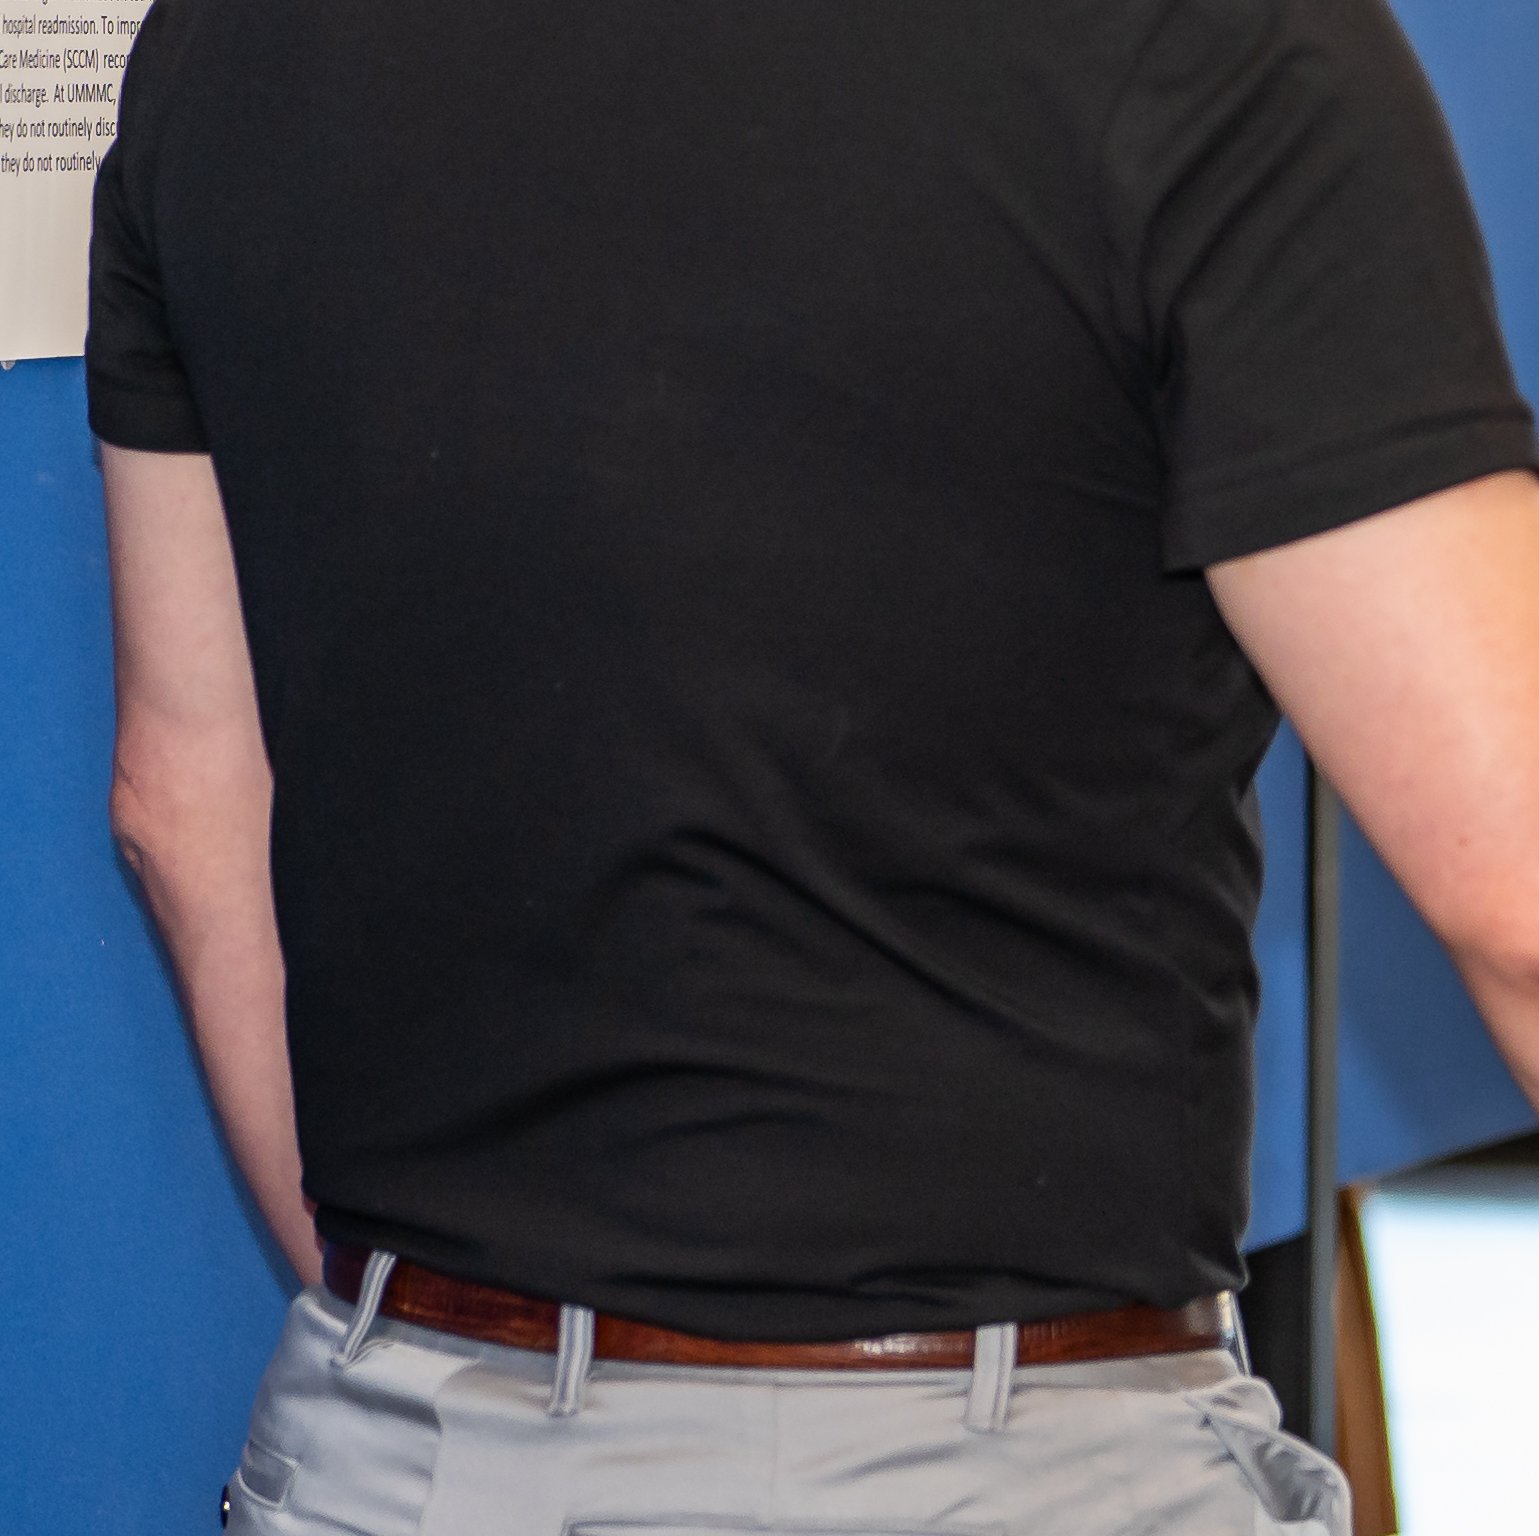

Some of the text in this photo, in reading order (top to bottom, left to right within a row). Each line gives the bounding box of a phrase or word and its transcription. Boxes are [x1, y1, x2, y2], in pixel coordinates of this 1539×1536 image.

[37, 14, 115, 36] readmission. To
[19, 48, 99, 73] Medicine (SCCM)
[53, 84, 116, 106] At UMMMC,
